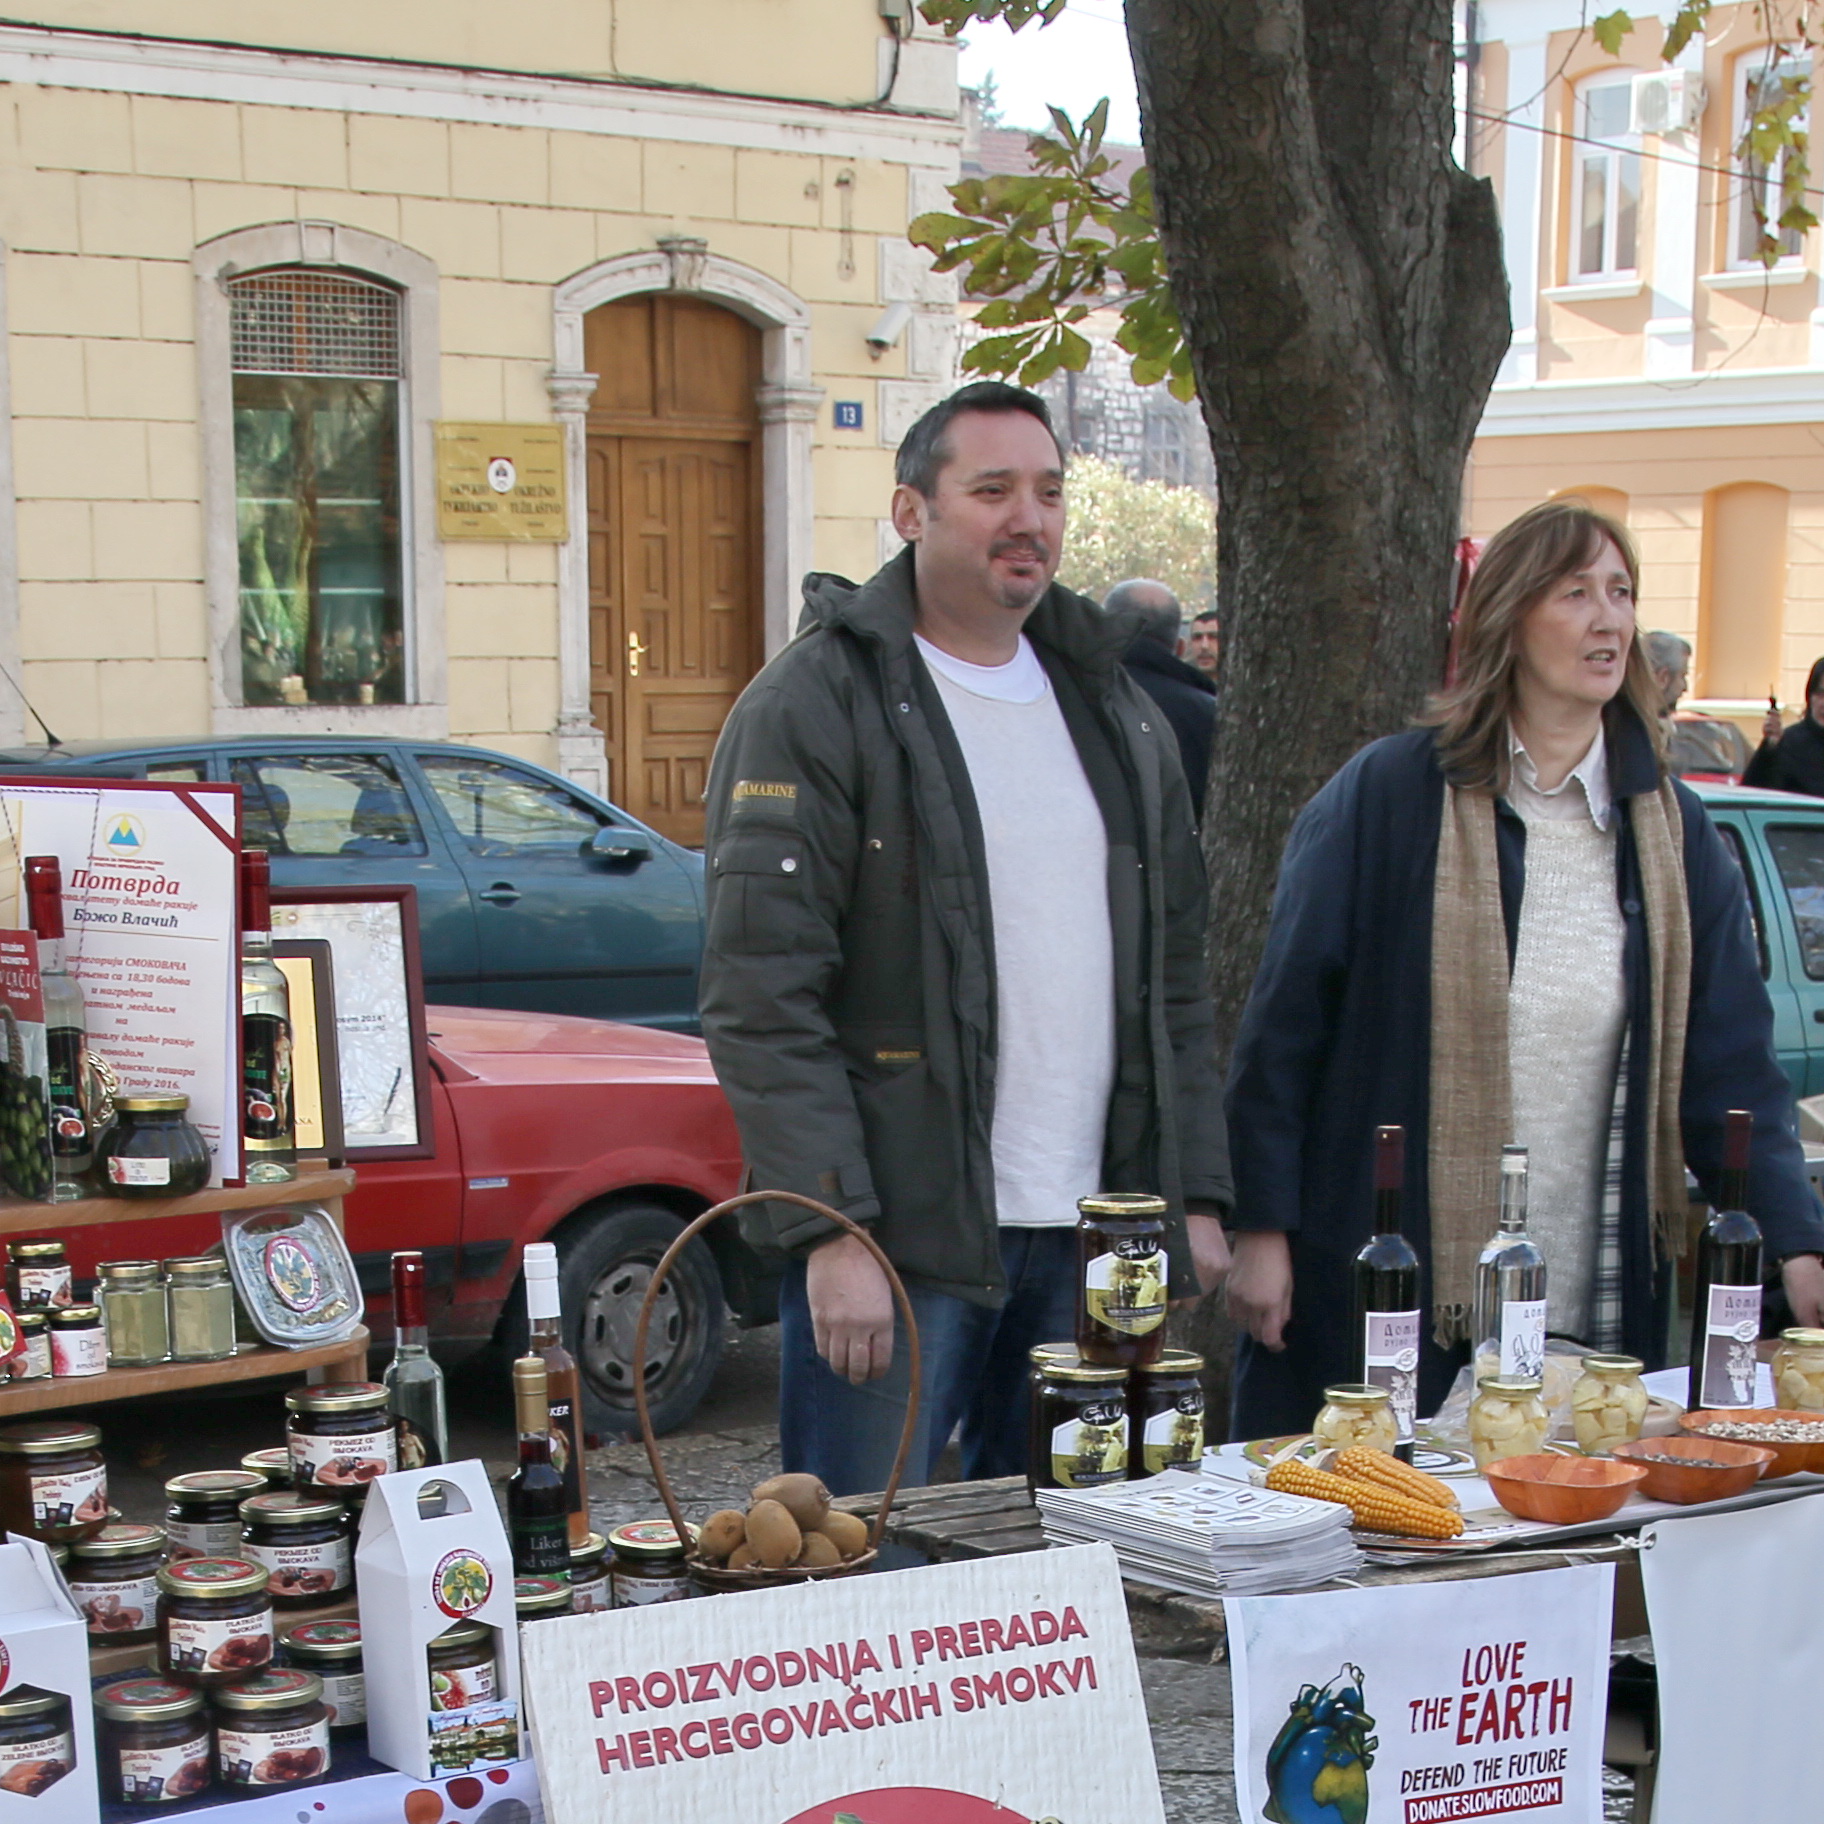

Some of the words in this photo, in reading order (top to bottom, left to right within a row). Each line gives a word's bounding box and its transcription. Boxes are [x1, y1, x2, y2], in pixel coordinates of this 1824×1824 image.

[842, 406, 856, 425] 13
[70, 869, 180, 897] Потврда
[122, 911, 179, 928] Влачић
[125, 957, 187, 971] СМОКОВАЧА
[530, 1536, 563, 1549] Liker
[588, 1637, 878, 1719] PROIZVODNJA
[891, 1632, 904, 1669] I
[911, 1604, 1090, 1664] PRERADA
[1462, 1641, 1527, 1689] LOVE
[596, 1683, 943, 1775] HERCEGOVAČKIH
[952, 1655, 1098, 1713] SMOKVI
[1409, 1696, 1452, 1735] THE
[1456, 1677, 1573, 1746] EARTH
[1400, 1763, 1465, 1795] DEFEND
[1473, 1757, 1503, 1785] THE
[1508, 1747, 1568, 1779] FUTURE
